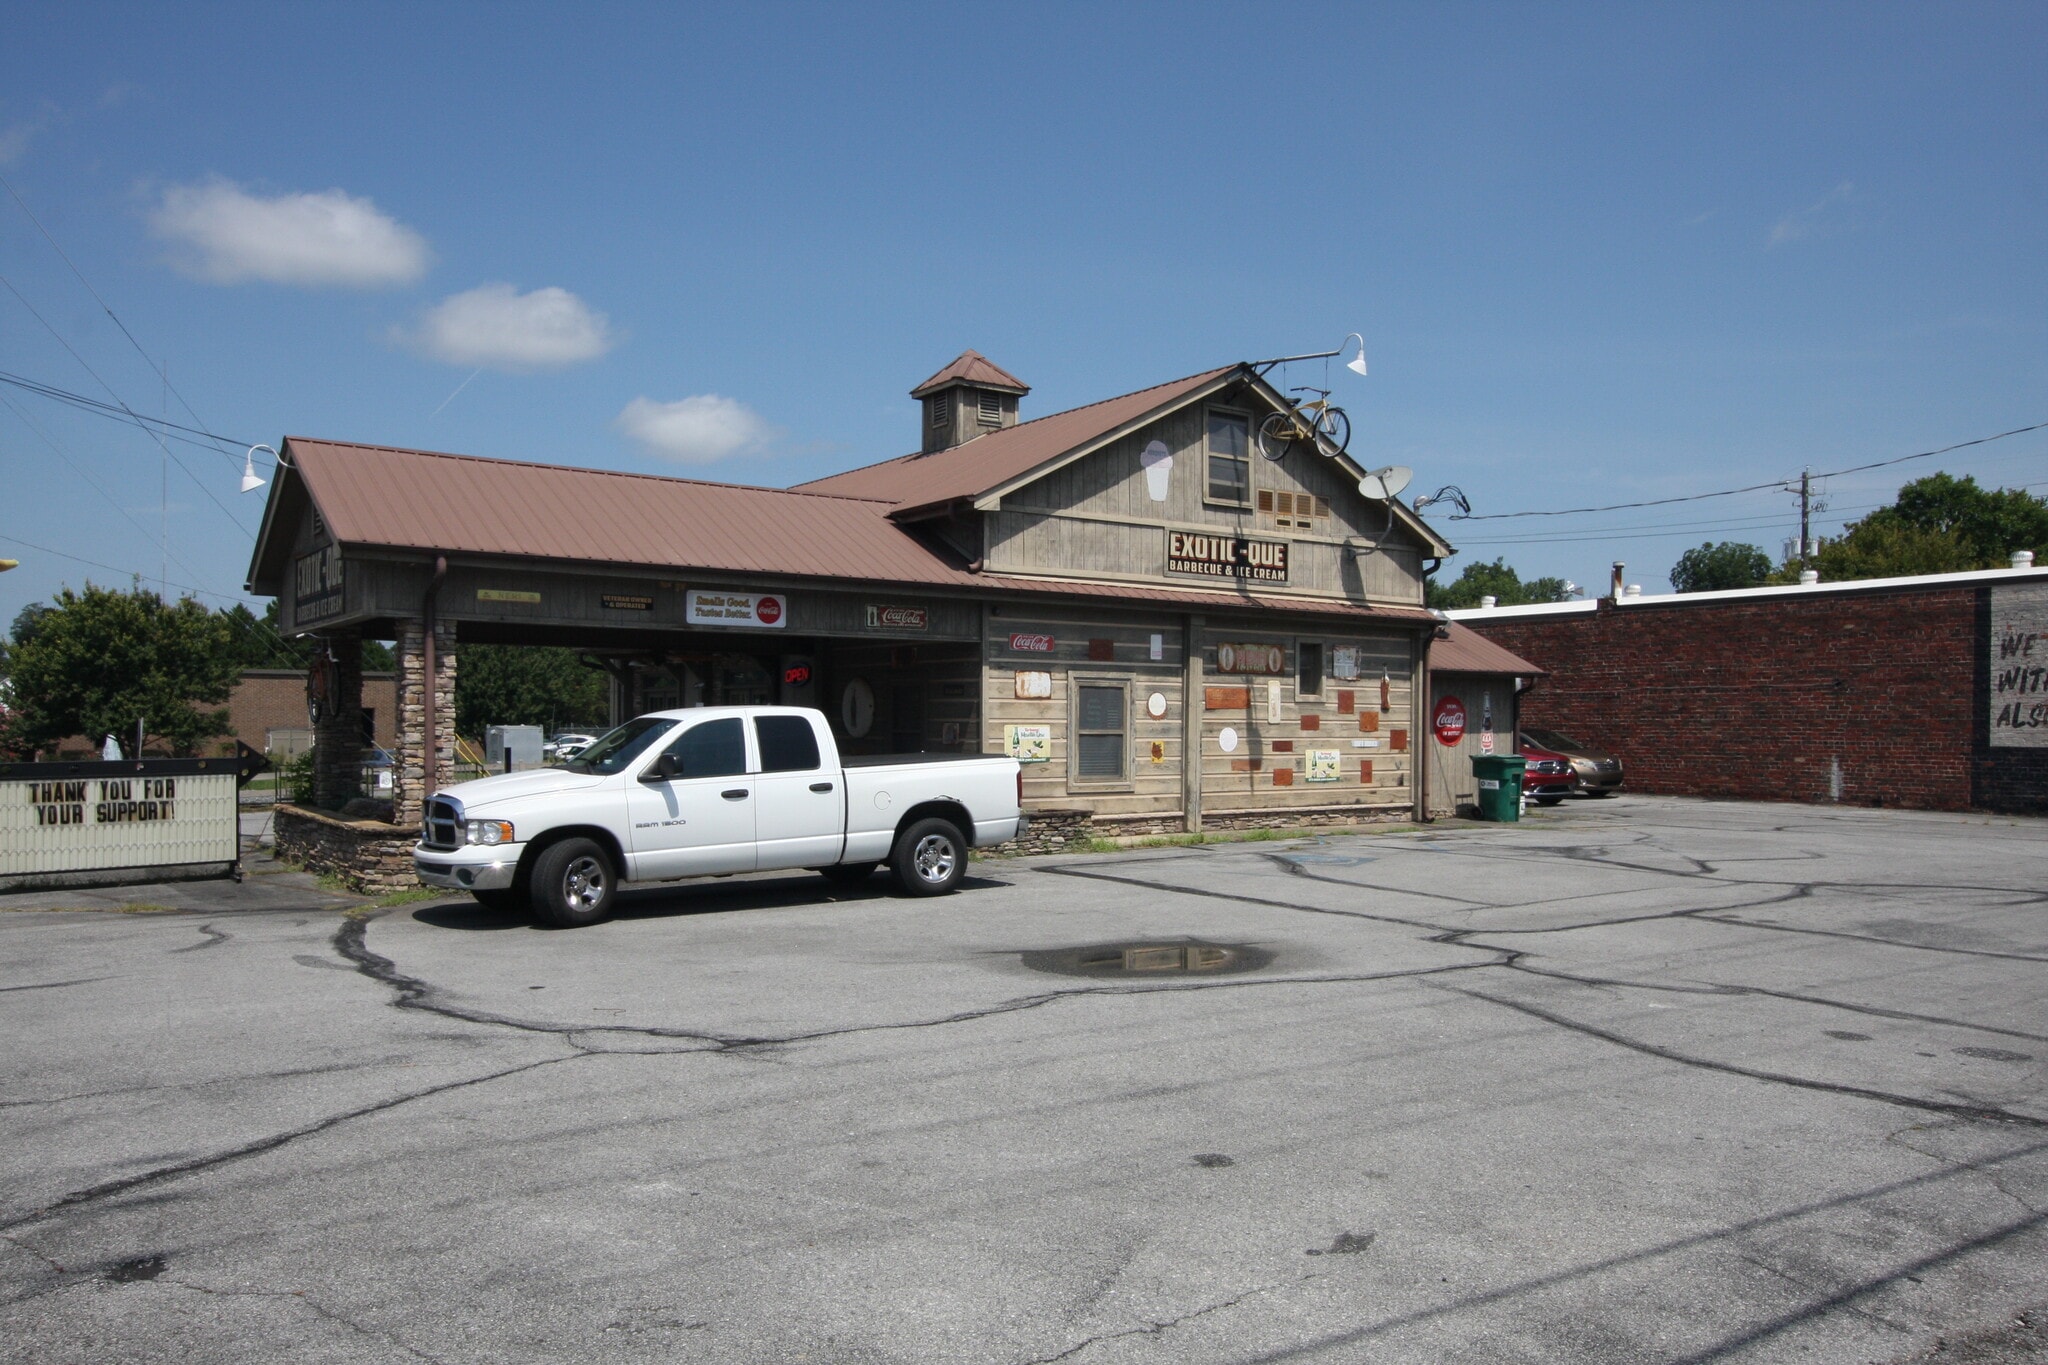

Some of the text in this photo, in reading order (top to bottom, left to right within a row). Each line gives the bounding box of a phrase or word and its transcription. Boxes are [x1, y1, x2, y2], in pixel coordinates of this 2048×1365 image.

[1169, 560, 1285, 581] BARBECUE & ICE CREAM
[696, 595, 751, 608] Smells Good.
[695, 606, 723, 618] Tastes
[2001, 633, 2038, 660] WE
[785, 667, 809, 683] OPEN
[28, 779, 175, 803] THANK YOU FOR
[38, 801, 175, 825] YOUR SUPPORT!
[661, 819, 687, 827] 1500
